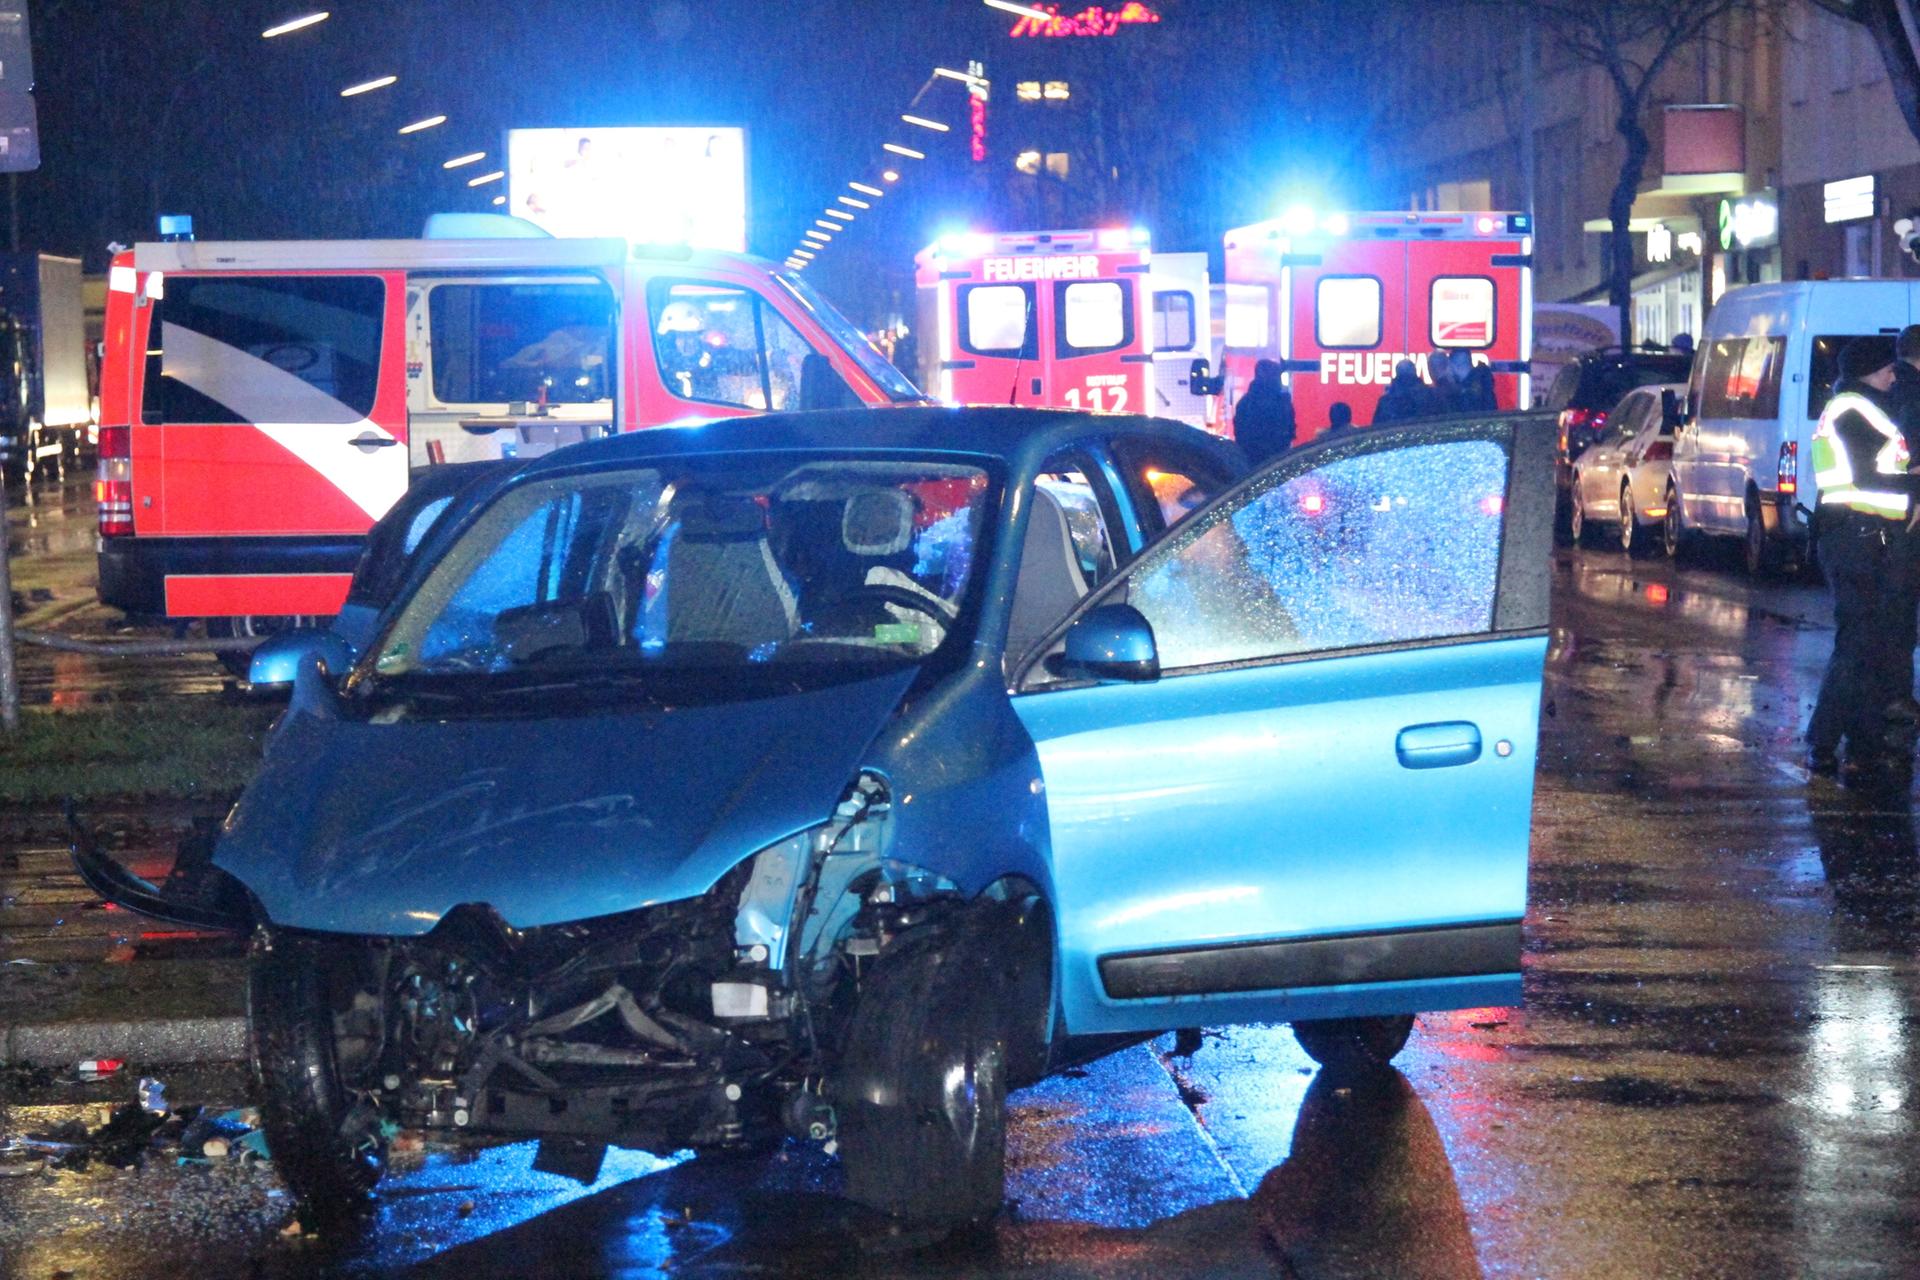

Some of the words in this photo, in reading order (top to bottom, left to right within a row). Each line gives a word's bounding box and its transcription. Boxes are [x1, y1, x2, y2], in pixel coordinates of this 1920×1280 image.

[983, 255, 1099, 281] FEUERWEHR
[1320, 352, 1490, 386] FEUEW
[1064, 386, 1128, 412] 112
